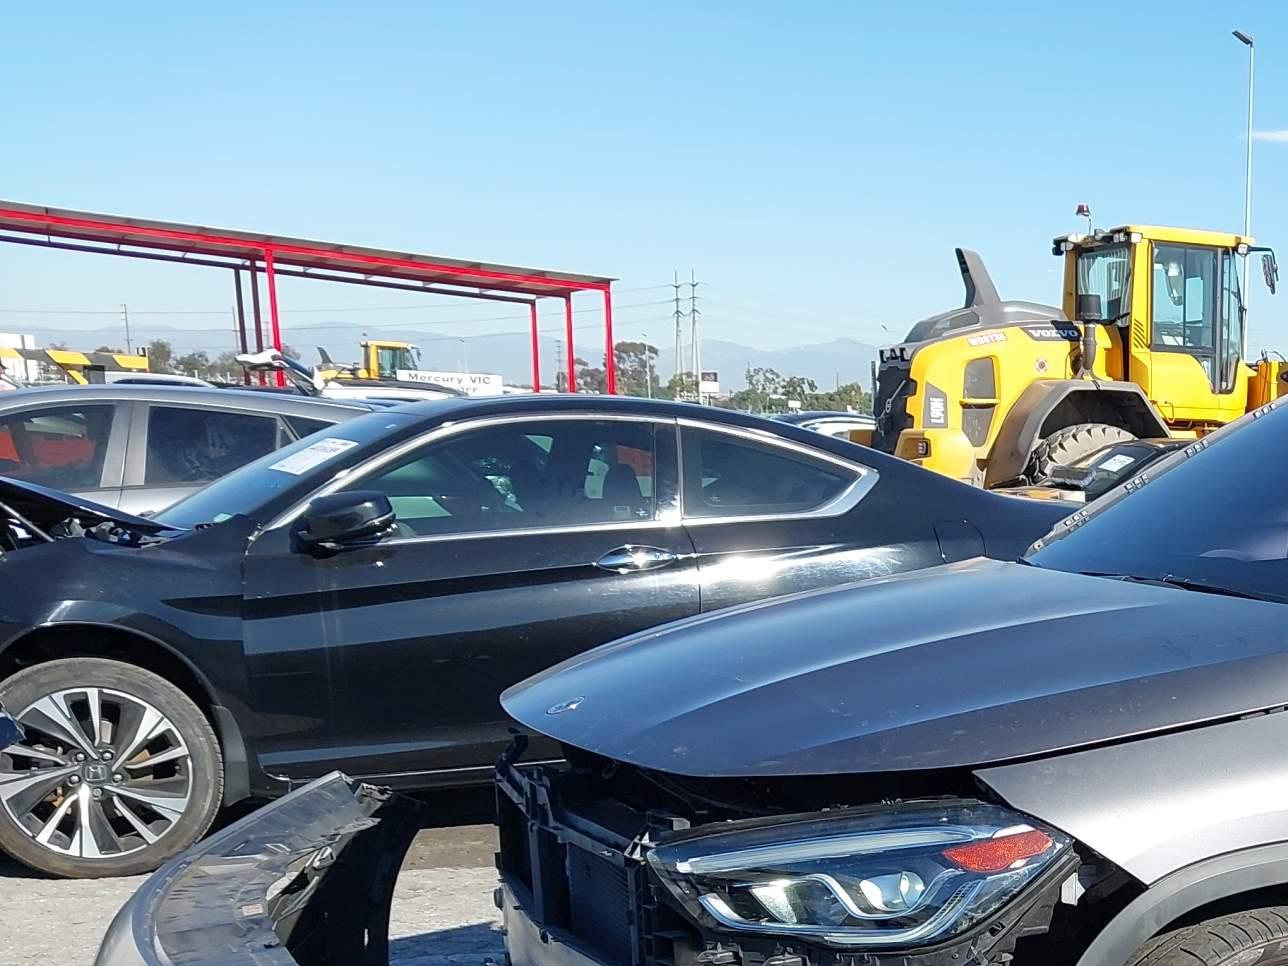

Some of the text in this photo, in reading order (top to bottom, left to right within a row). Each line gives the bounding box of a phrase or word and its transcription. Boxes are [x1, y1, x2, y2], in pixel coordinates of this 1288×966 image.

[1028, 328, 1079, 338] VOLVO
[408, 373, 491, 384] Mercury VIC
